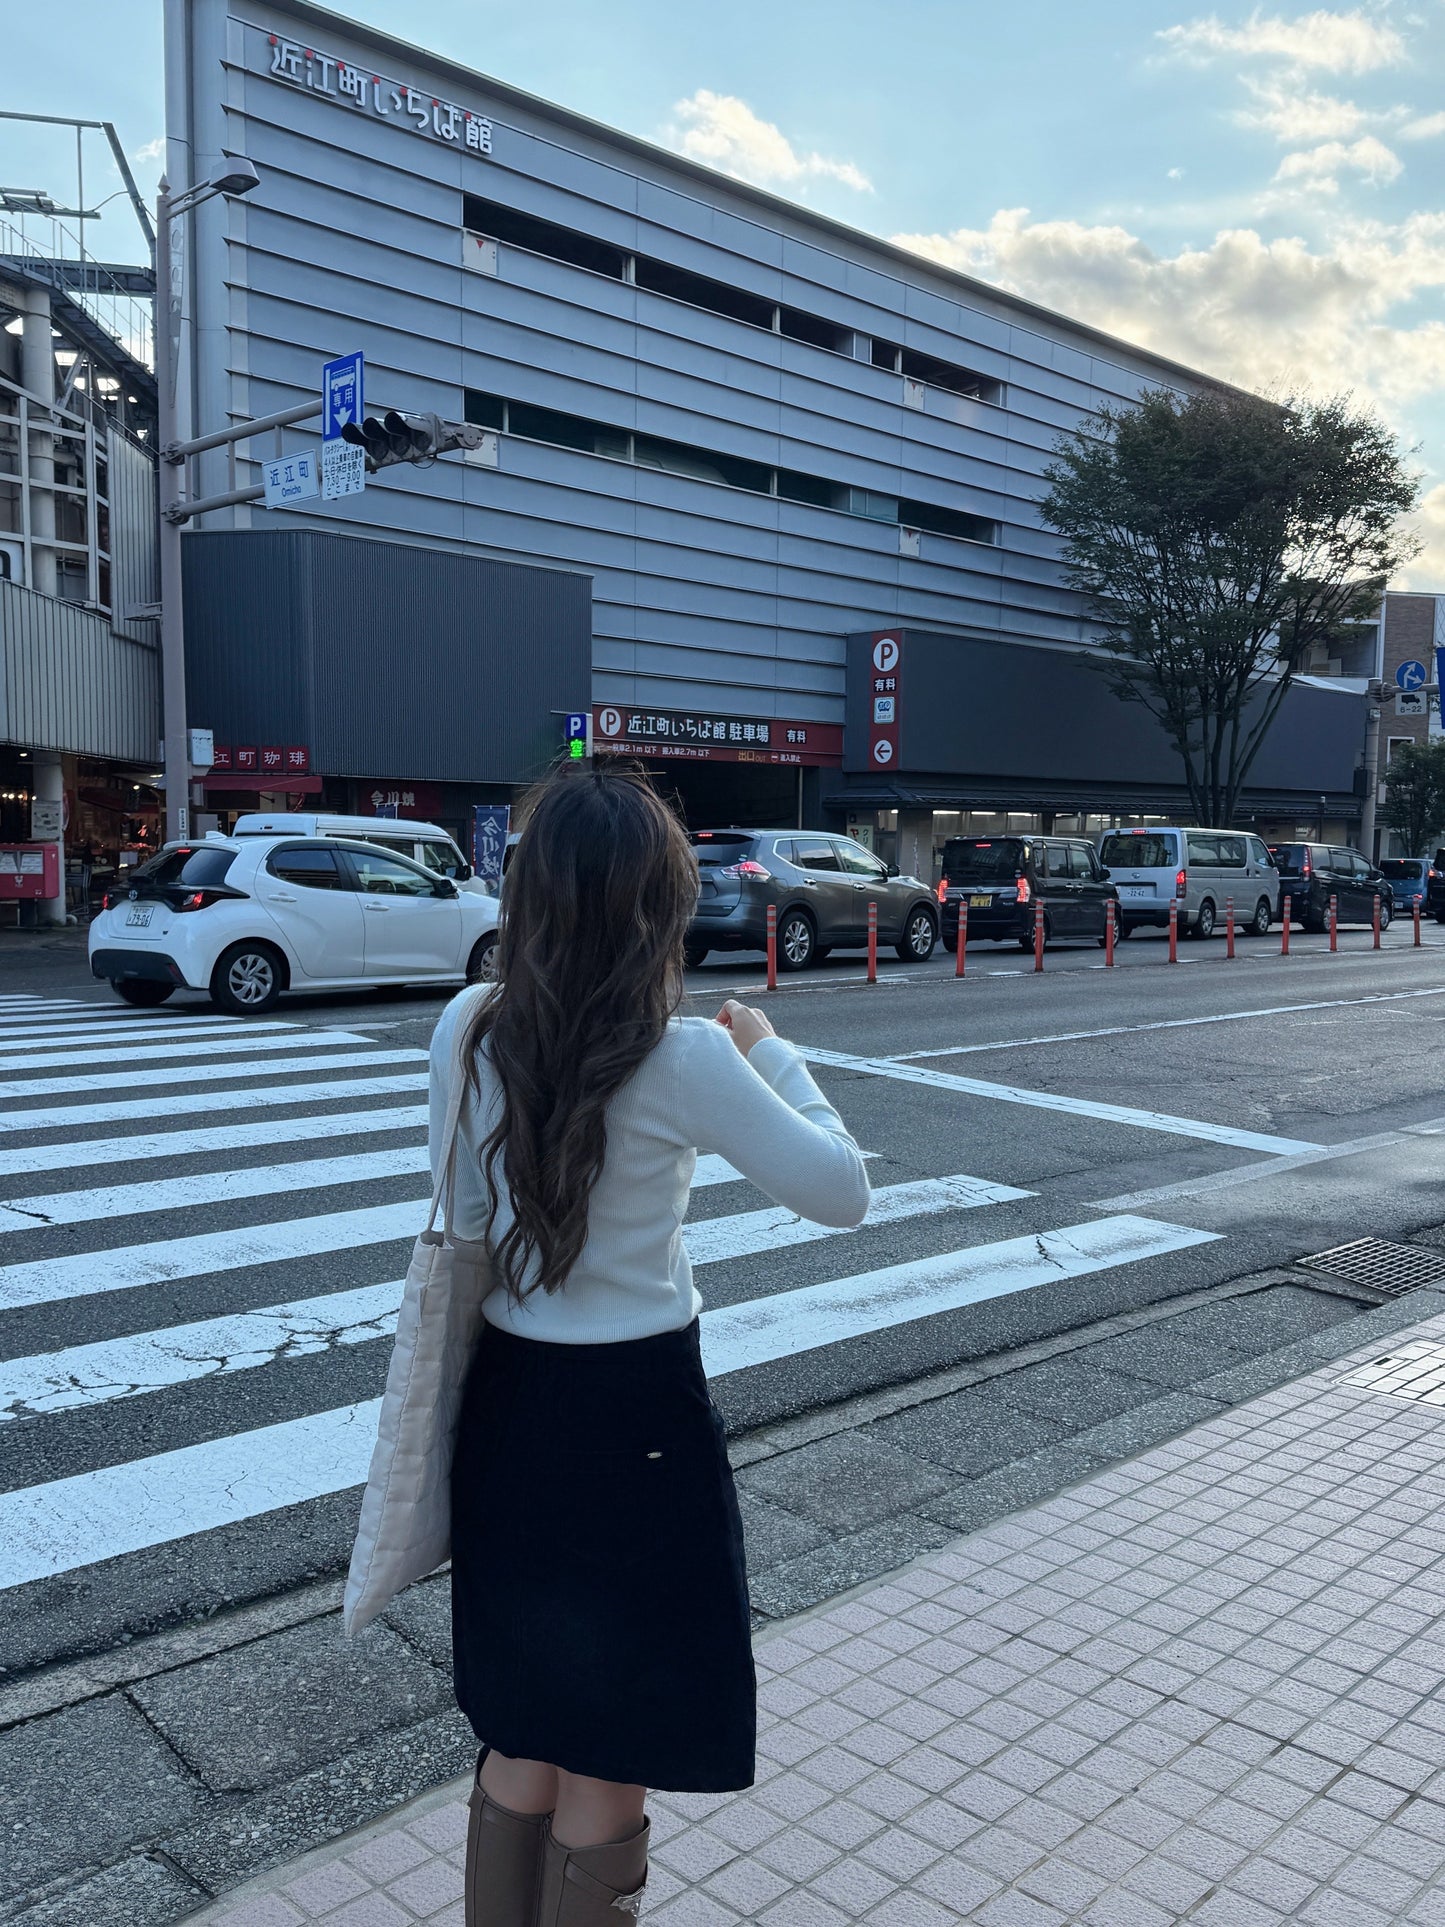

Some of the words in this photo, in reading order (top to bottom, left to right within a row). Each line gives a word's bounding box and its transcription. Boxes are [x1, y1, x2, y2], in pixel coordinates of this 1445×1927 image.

[269, 35, 493, 154] 近江町いちば館
[333, 387, 353, 407] 専用
[269, 460, 309, 487] 近江町
[326, 481, 361, 496] ここまで
[874, 678, 896, 692] 有料
[786, 729, 807, 743] 有料
